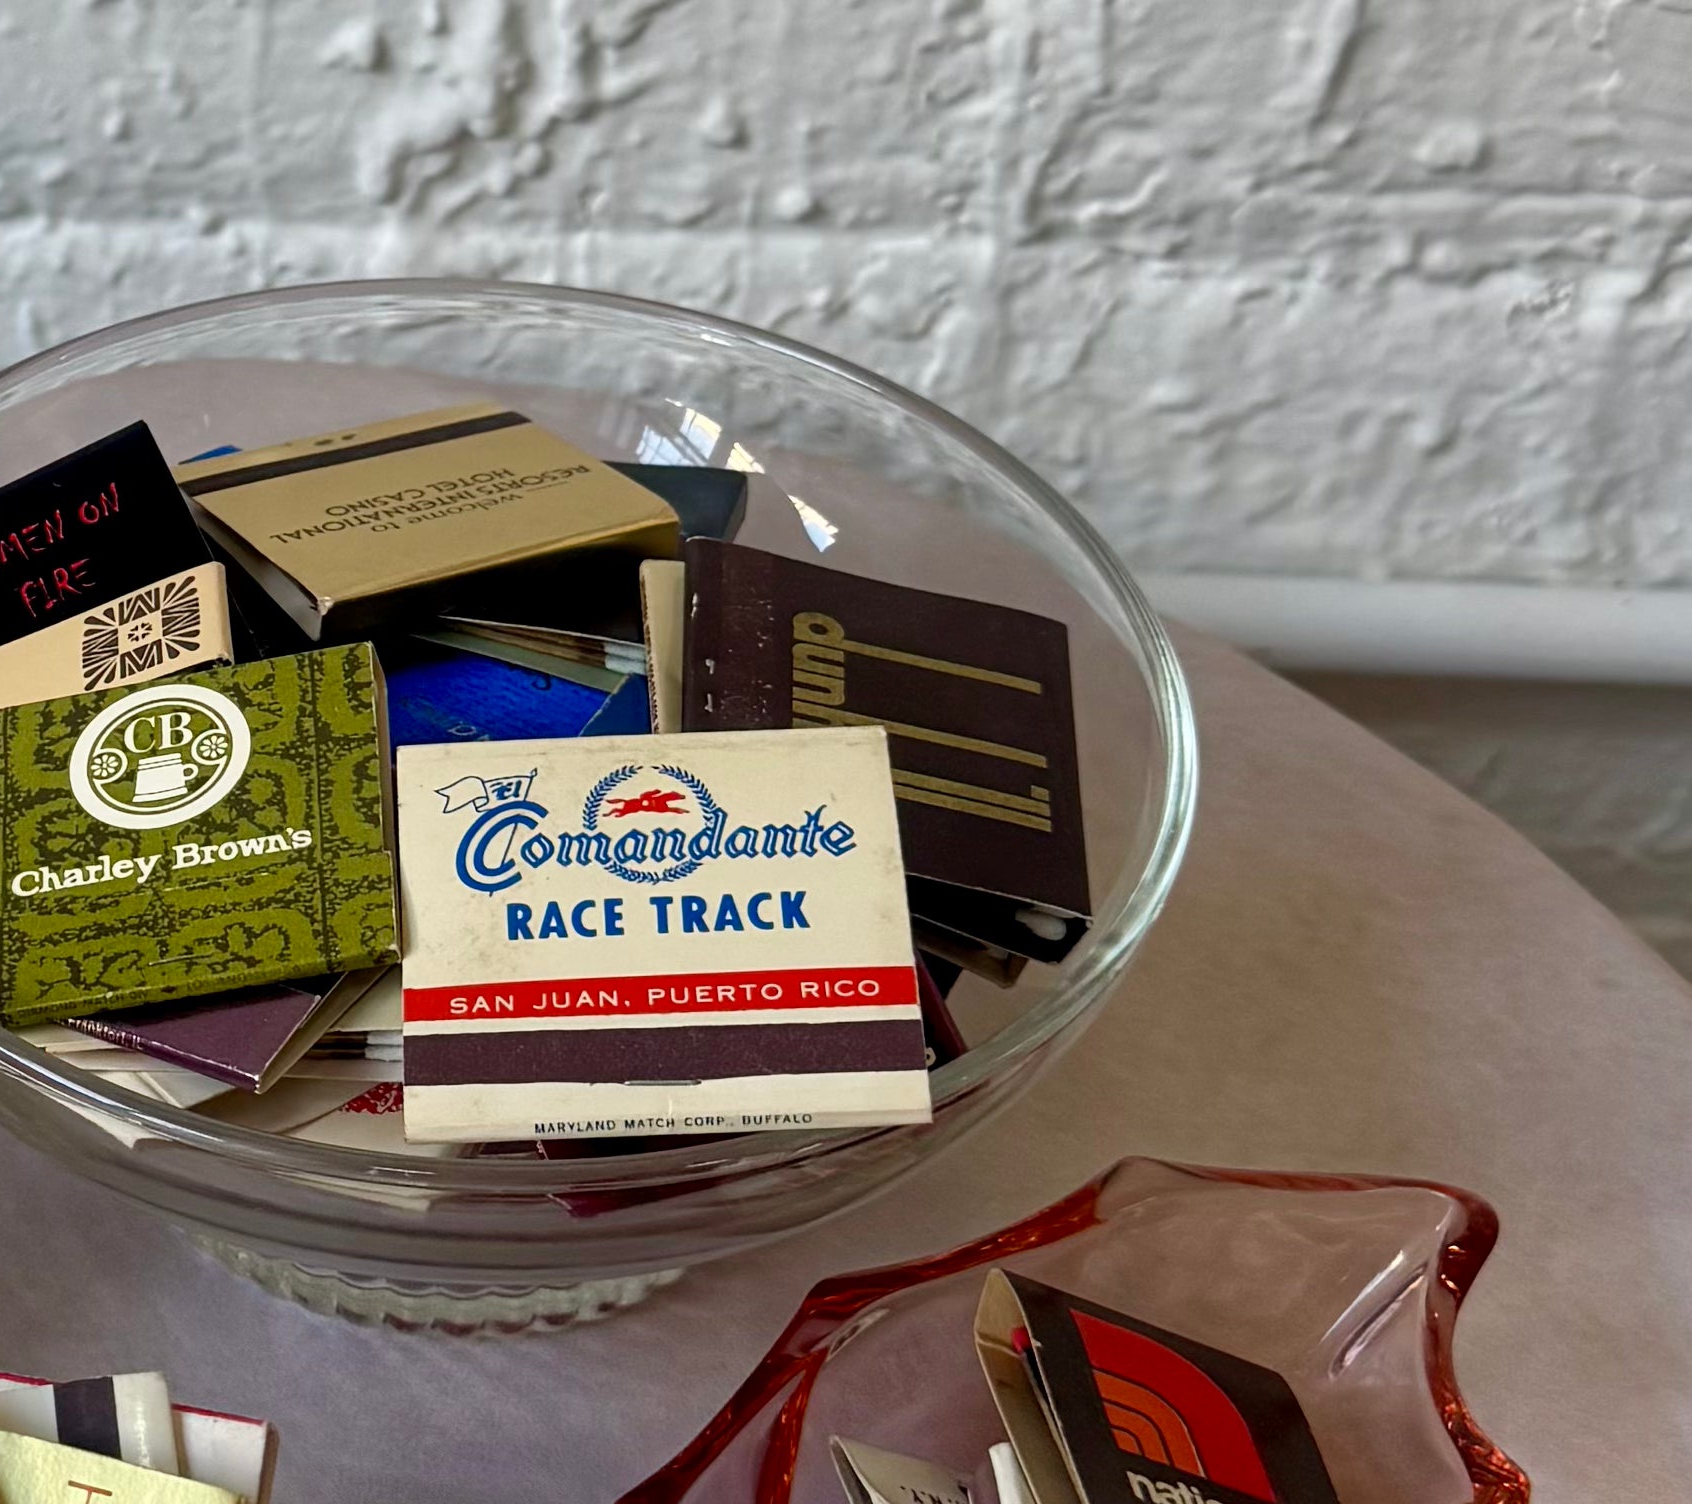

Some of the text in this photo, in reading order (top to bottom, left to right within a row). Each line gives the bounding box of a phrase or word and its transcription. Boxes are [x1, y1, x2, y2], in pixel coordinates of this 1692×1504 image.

[79, 482, 120, 527] ON
[270, 464, 590, 544] RESORTS INTERNATIONAL
[326, 468, 515, 517] HOTEL CASINO
[372, 494, 522, 534] welcome to
[20, 556, 96, 618] FIRE
[124, 710, 193, 754] CB
[793, 611, 1053, 833] dunhll
[11, 824, 313, 899] Charley Brown's
[456, 799, 856, 895] Comandante
[506, 889, 811, 942] RACE TRACK
[449, 977, 882, 1015] SAN JUAN, PUERTO RICO
[534, 1119, 617, 1135] MARYLAND
[624, 1116, 676, 1131] MATCH
[741, 1111, 814, 1126] BUFFALO
